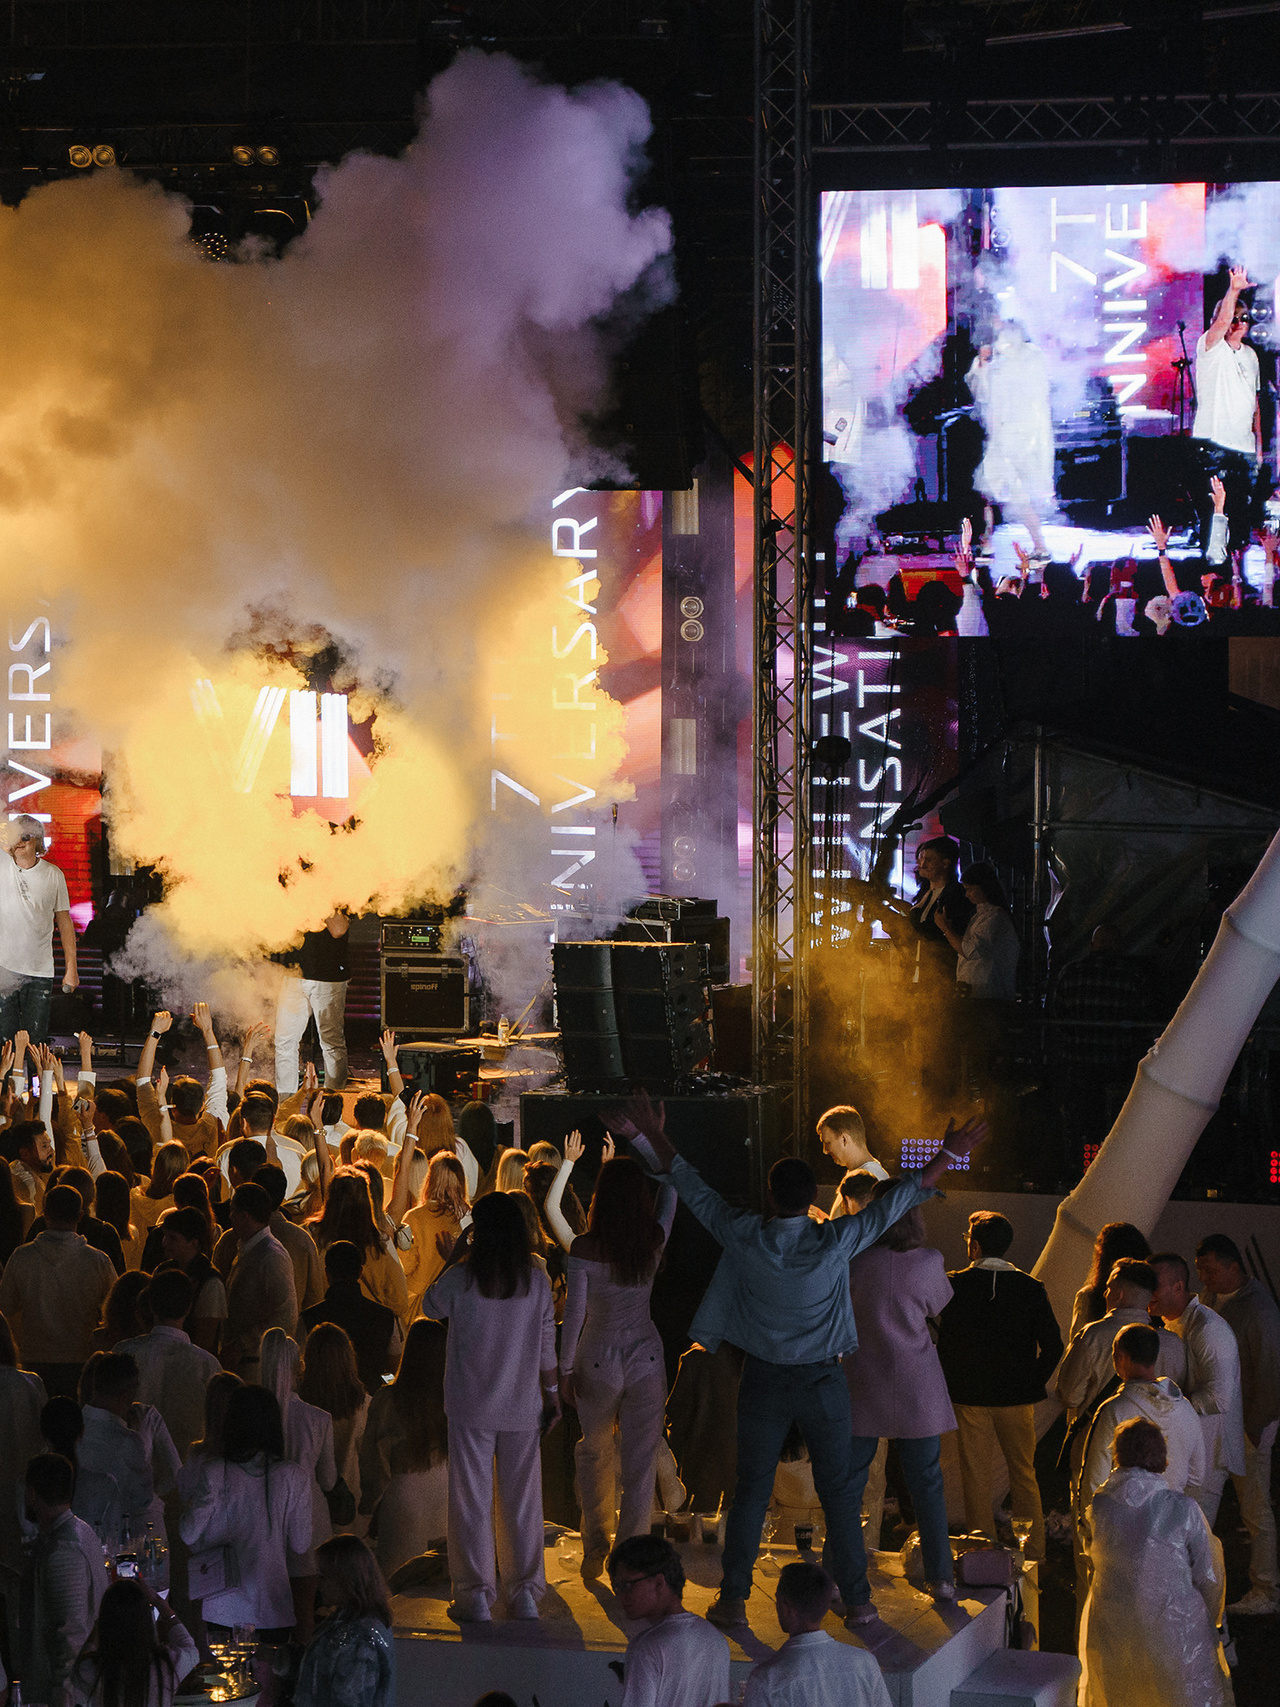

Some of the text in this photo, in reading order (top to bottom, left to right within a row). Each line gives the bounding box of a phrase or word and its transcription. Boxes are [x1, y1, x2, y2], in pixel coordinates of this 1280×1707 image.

[1103, 184, 1148, 416] NNIVE
[490, 658, 541, 811] 7T
[549, 486, 599, 910] NIVERSAR
